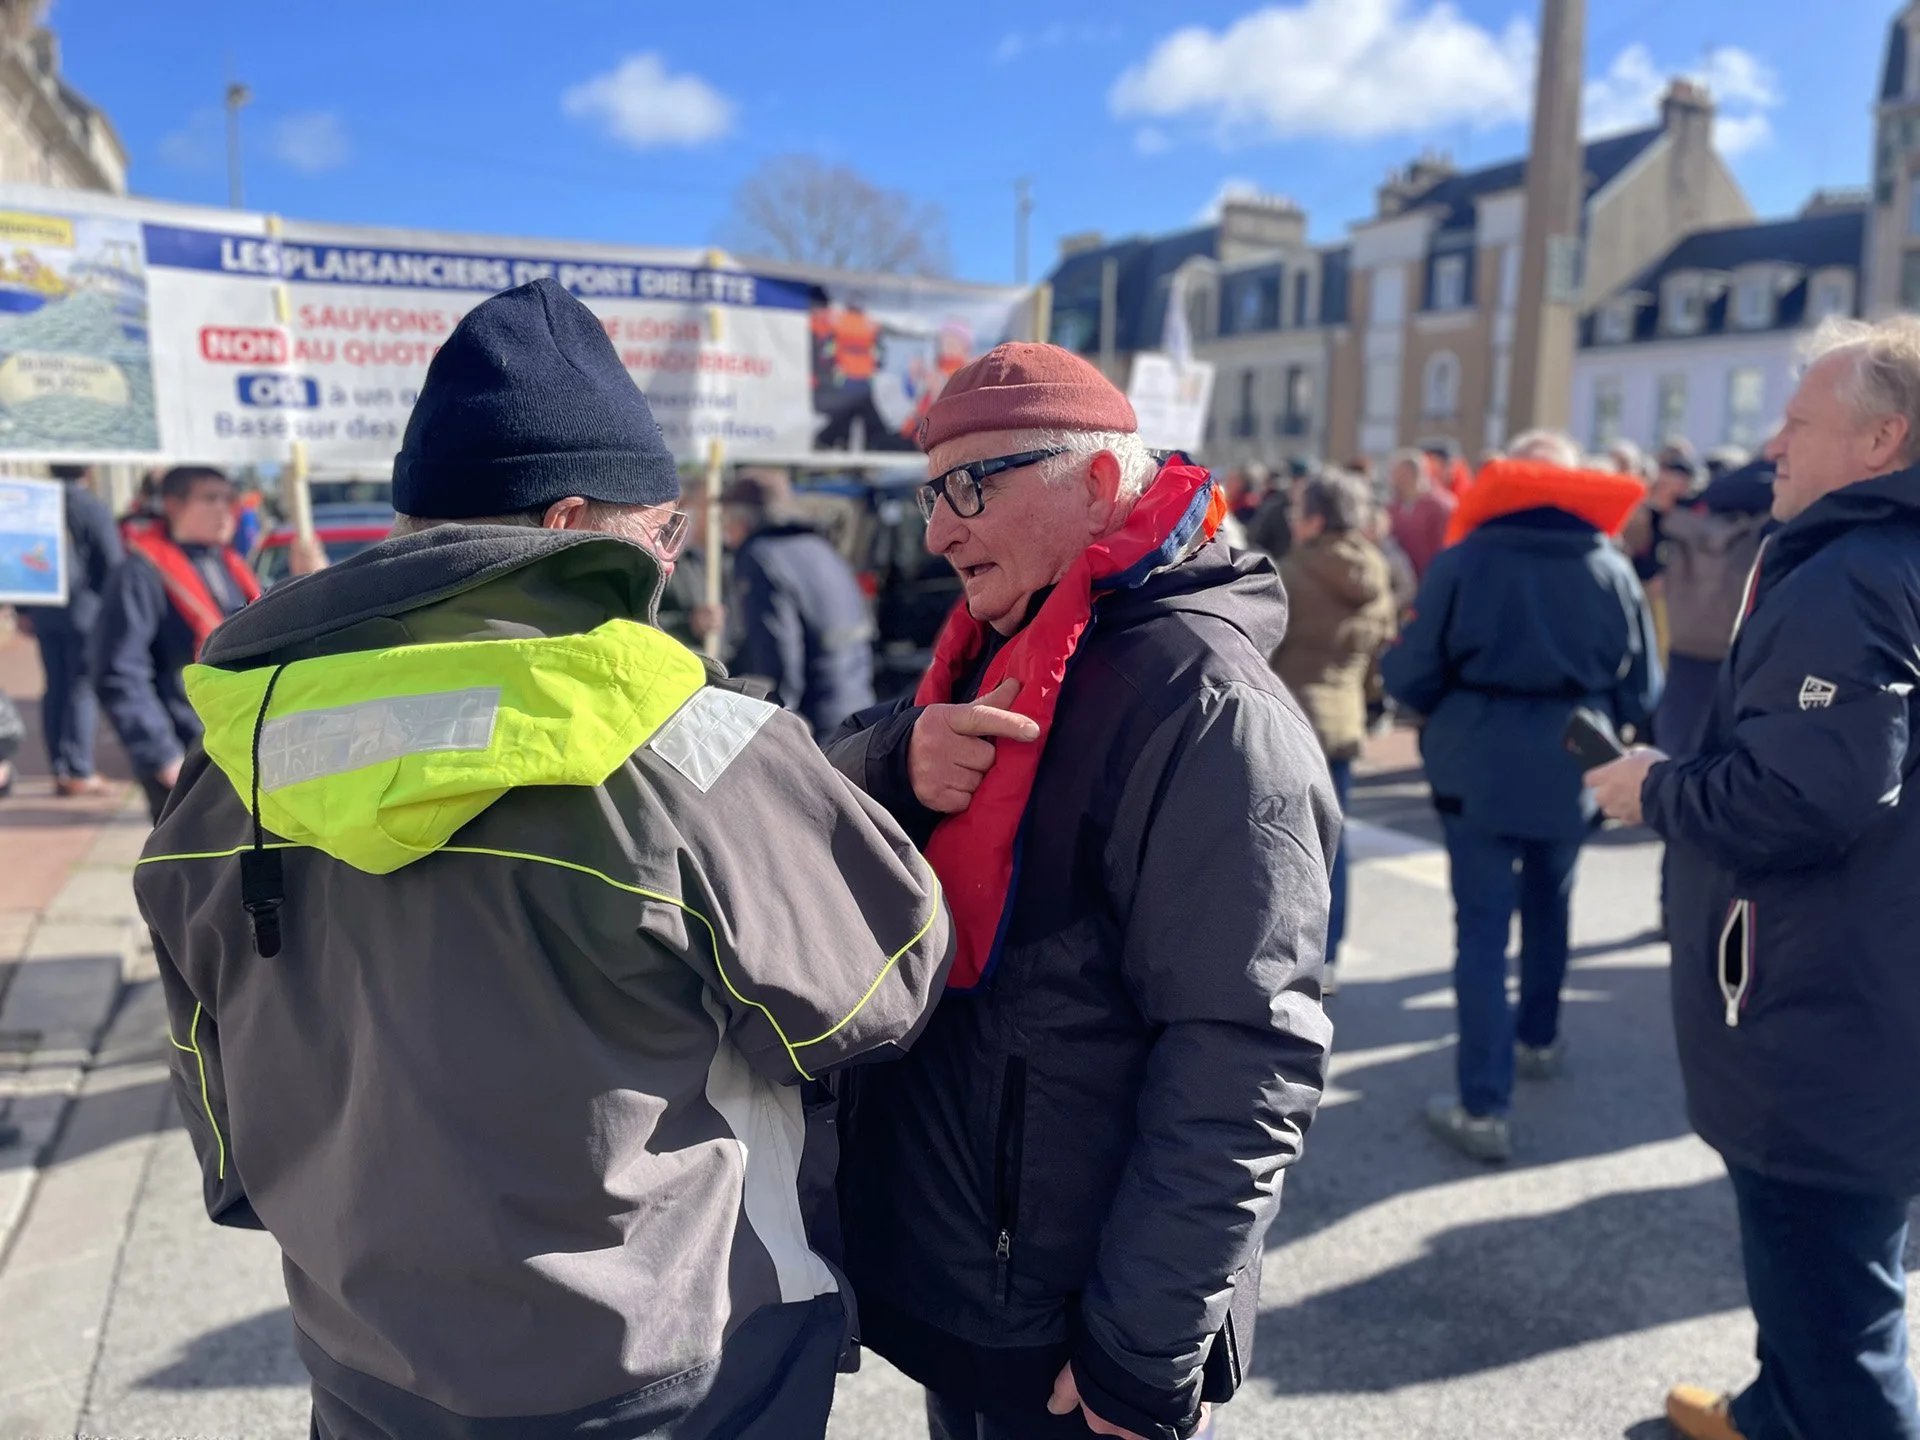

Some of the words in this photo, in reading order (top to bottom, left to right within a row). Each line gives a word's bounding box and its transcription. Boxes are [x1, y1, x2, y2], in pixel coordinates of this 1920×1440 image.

[221, 238, 280, 274] LES
[281, 247, 510, 290] PLAISANCIERS
[558, 264, 635, 297] PORT
[299, 305, 450, 334] SAUVONS
[205, 330, 283, 360] NON
[294, 338, 337, 363] AU
